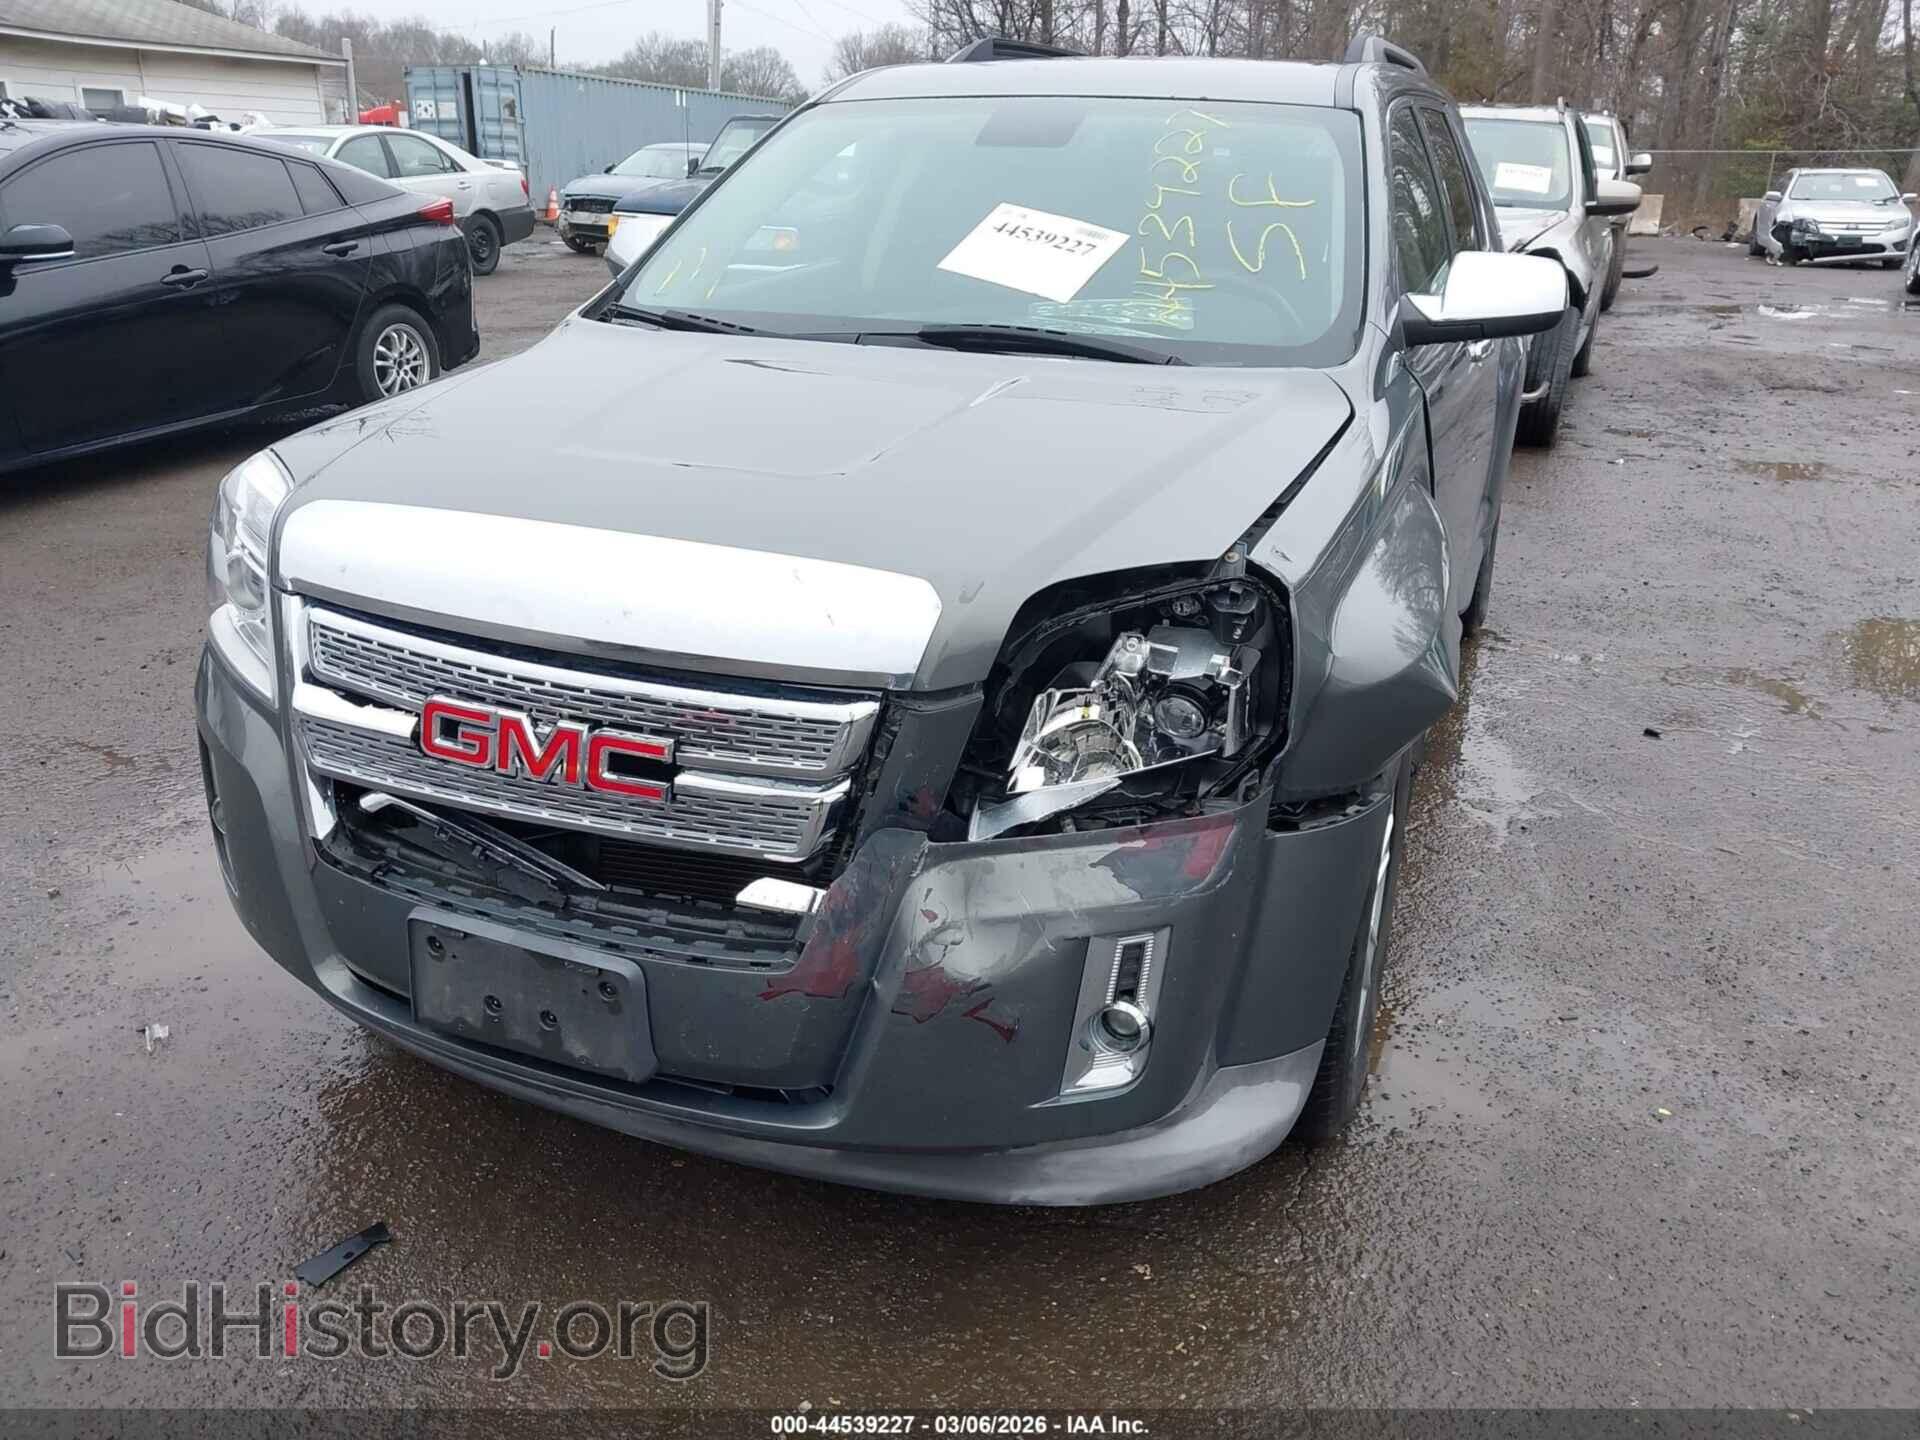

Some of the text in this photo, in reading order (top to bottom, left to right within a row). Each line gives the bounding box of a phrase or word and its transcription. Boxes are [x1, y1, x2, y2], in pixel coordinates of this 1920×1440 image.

[993, 221, 1097, 257] 44539227
[1227, 171, 1317, 281] SF
[420, 694, 675, 801] GMC
